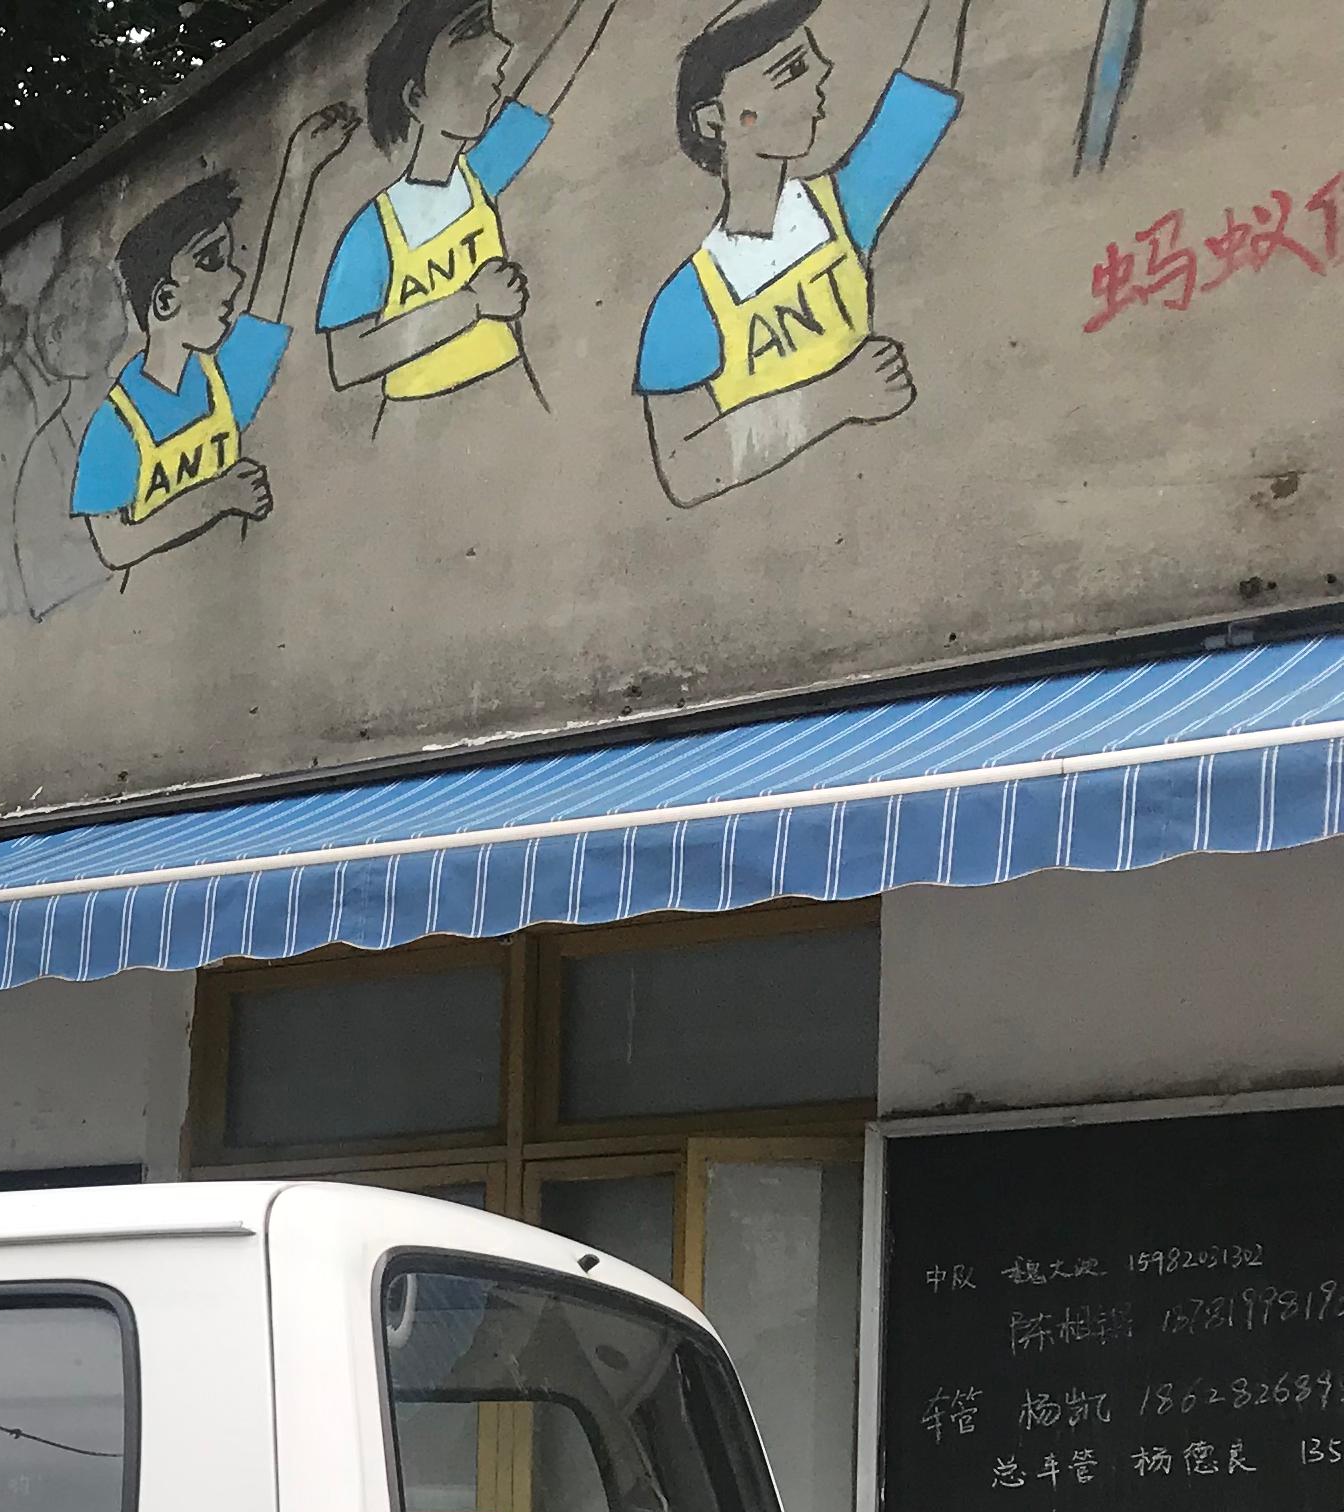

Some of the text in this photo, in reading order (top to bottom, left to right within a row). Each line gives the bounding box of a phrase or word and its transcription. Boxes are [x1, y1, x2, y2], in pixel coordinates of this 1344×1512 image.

[399, 229, 484, 306] ANT
[746, 253, 857, 375] ANT
[145, 432, 232, 503] ANT
[925, 1263, 977, 1293] 中队
[992, 1449, 1098, 1490] 总车管
[1130, 1440, 1258, 1478] 杨德良
